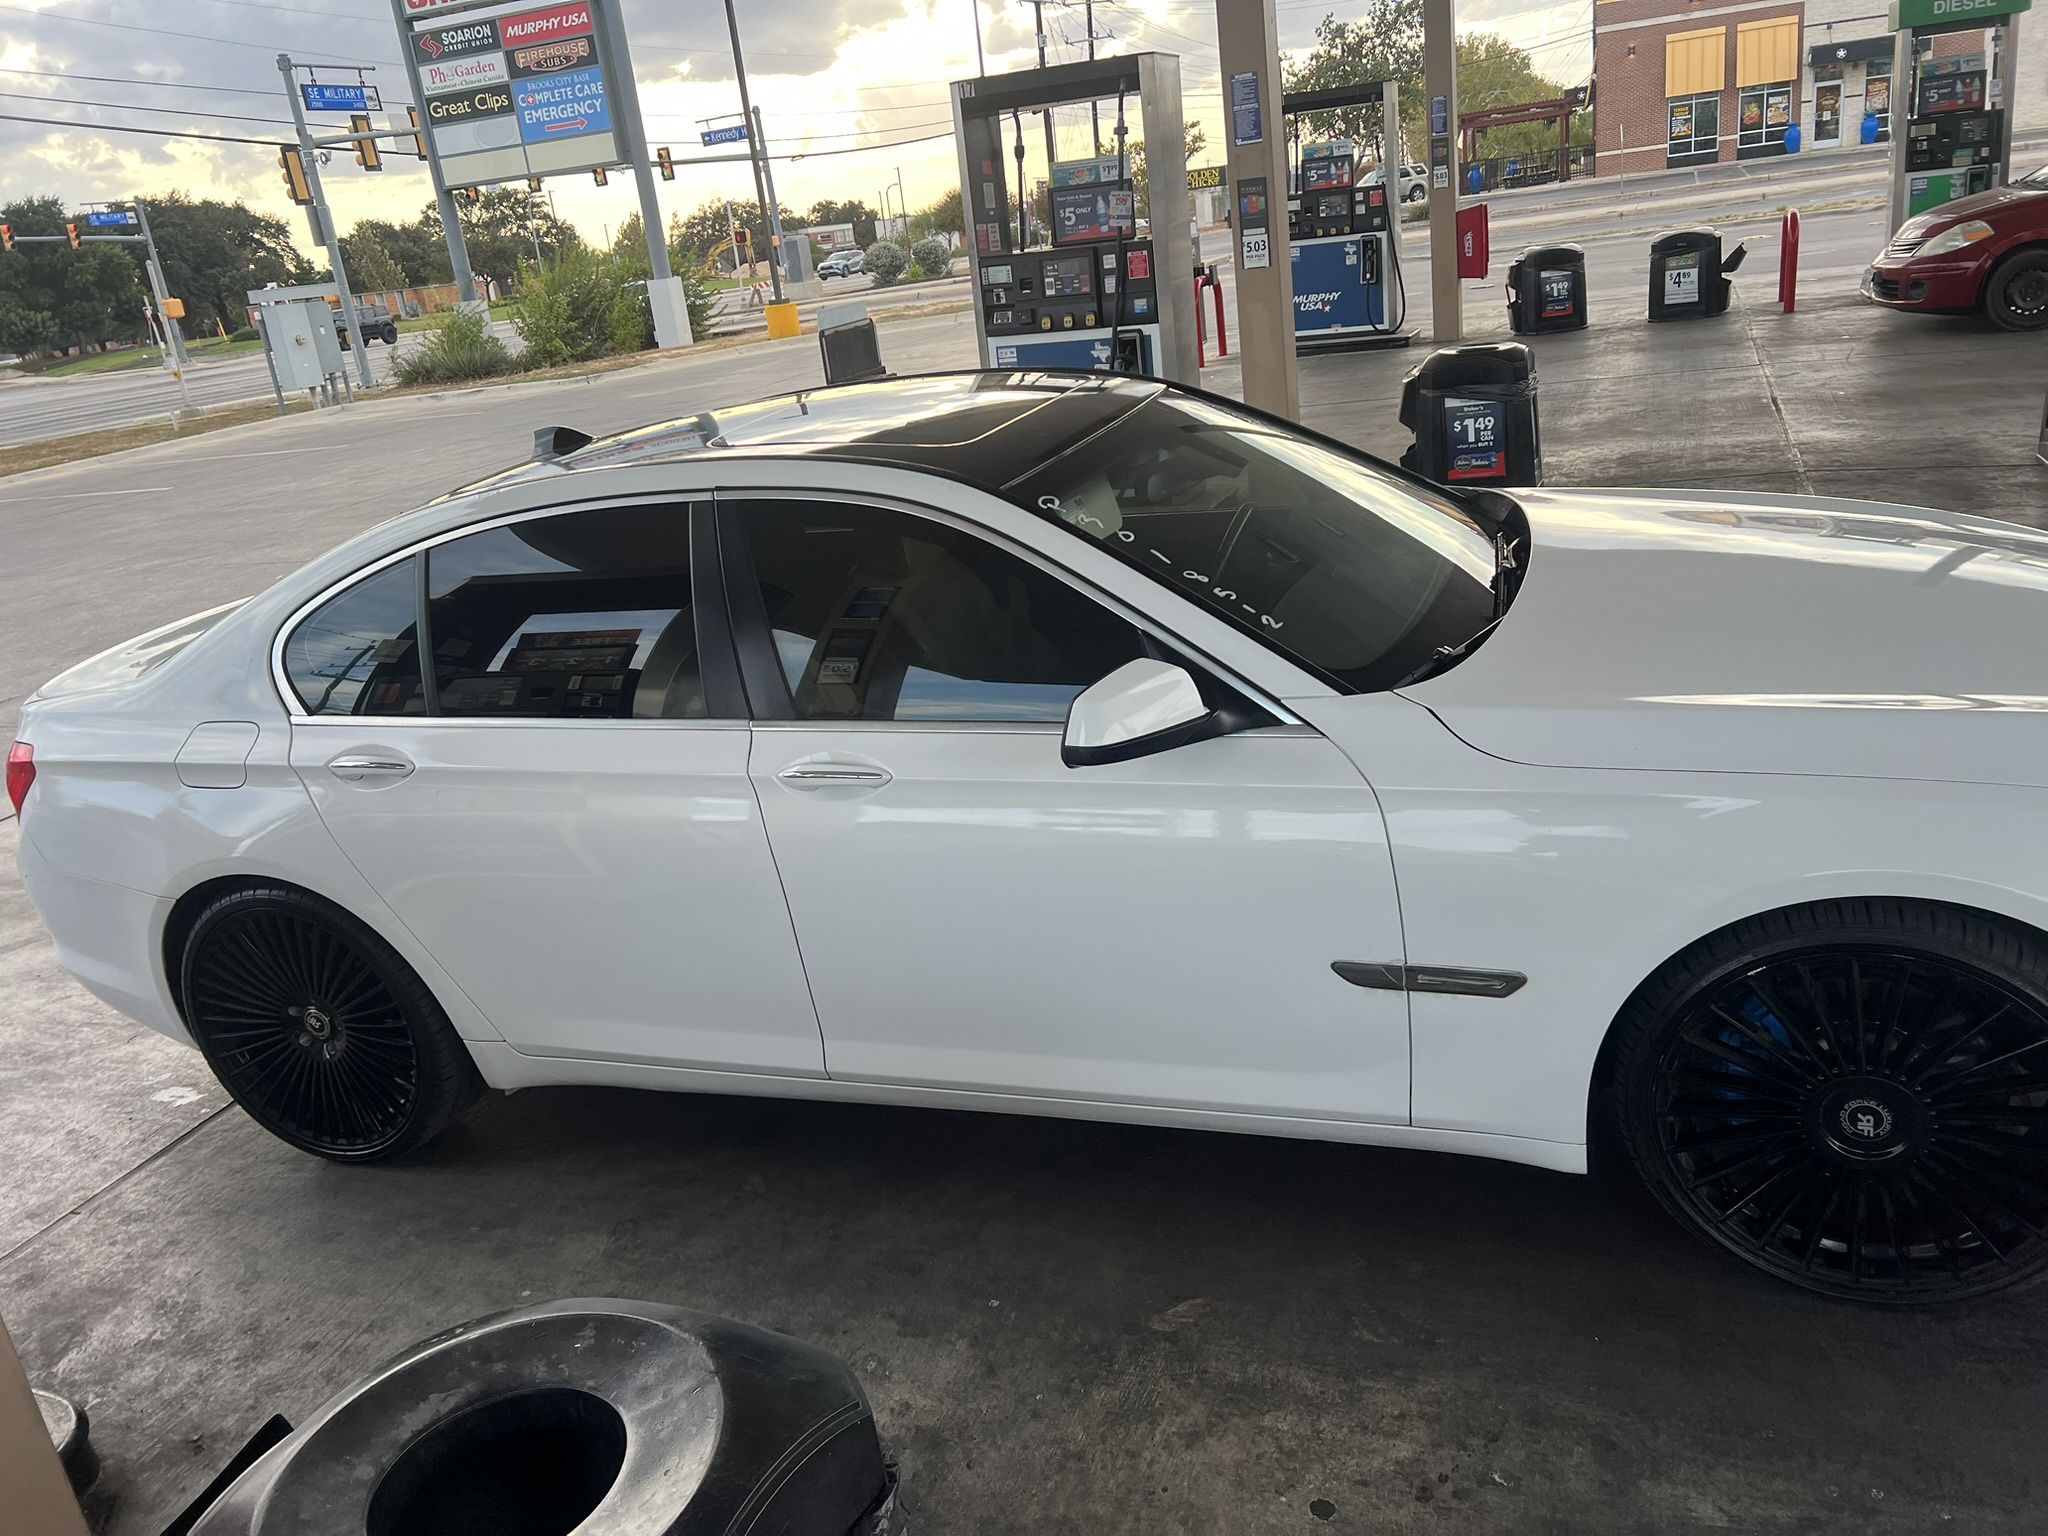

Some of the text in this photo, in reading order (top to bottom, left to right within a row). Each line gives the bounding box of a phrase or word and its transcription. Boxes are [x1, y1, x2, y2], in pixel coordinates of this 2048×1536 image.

[506, 12, 588, 38] MURPHY USA
[441, 24, 492, 45] SOARION
[444, 38, 493, 52] CREDIT UNION
[517, 42, 588, 69] FIREHOUSE
[541, 56, 567, 69] SUBS
[455, 61, 496, 77] Garden
[527, 73, 591, 91] BROOKS CITY BASE
[961, 82, 975, 98] 17
[308, 87, 361, 99] SE MILITARY
[518, 82, 604, 107] COMPLETE CARE
[430, 93, 509, 117] Great Clips
[524, 98, 602, 124] EMERGENCY
[710, 128, 739, 143] Kennedy
[1059, 207, 1077, 226] $5
[1292, 291, 1341, 304] MURPHY
[1300, 302, 1323, 312] USA
